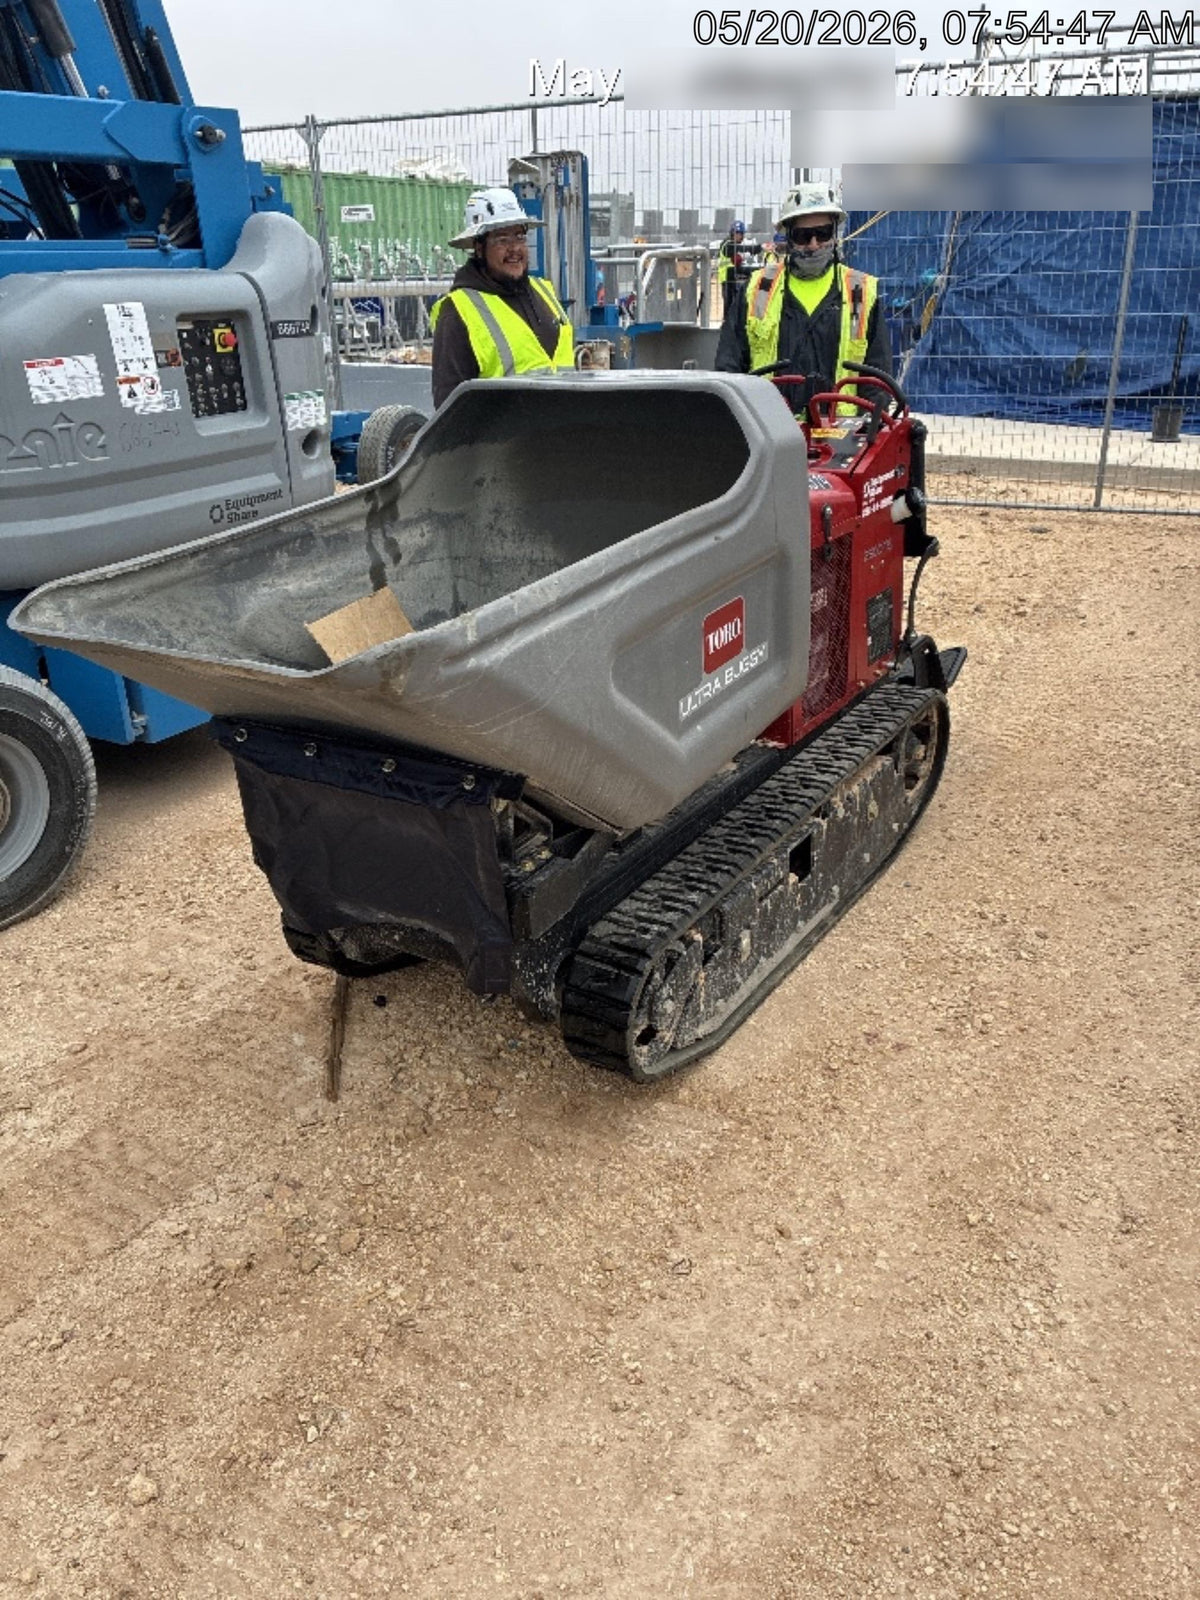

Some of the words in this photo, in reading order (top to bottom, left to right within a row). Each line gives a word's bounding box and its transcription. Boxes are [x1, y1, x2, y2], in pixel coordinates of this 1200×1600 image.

[224, 488, 283, 511] Equipment
[226, 509, 259, 524] Share
[706, 616, 741, 655] TORO
[680, 676, 721, 718] ULTRA
[724, 643, 767, 686] BUGGY
